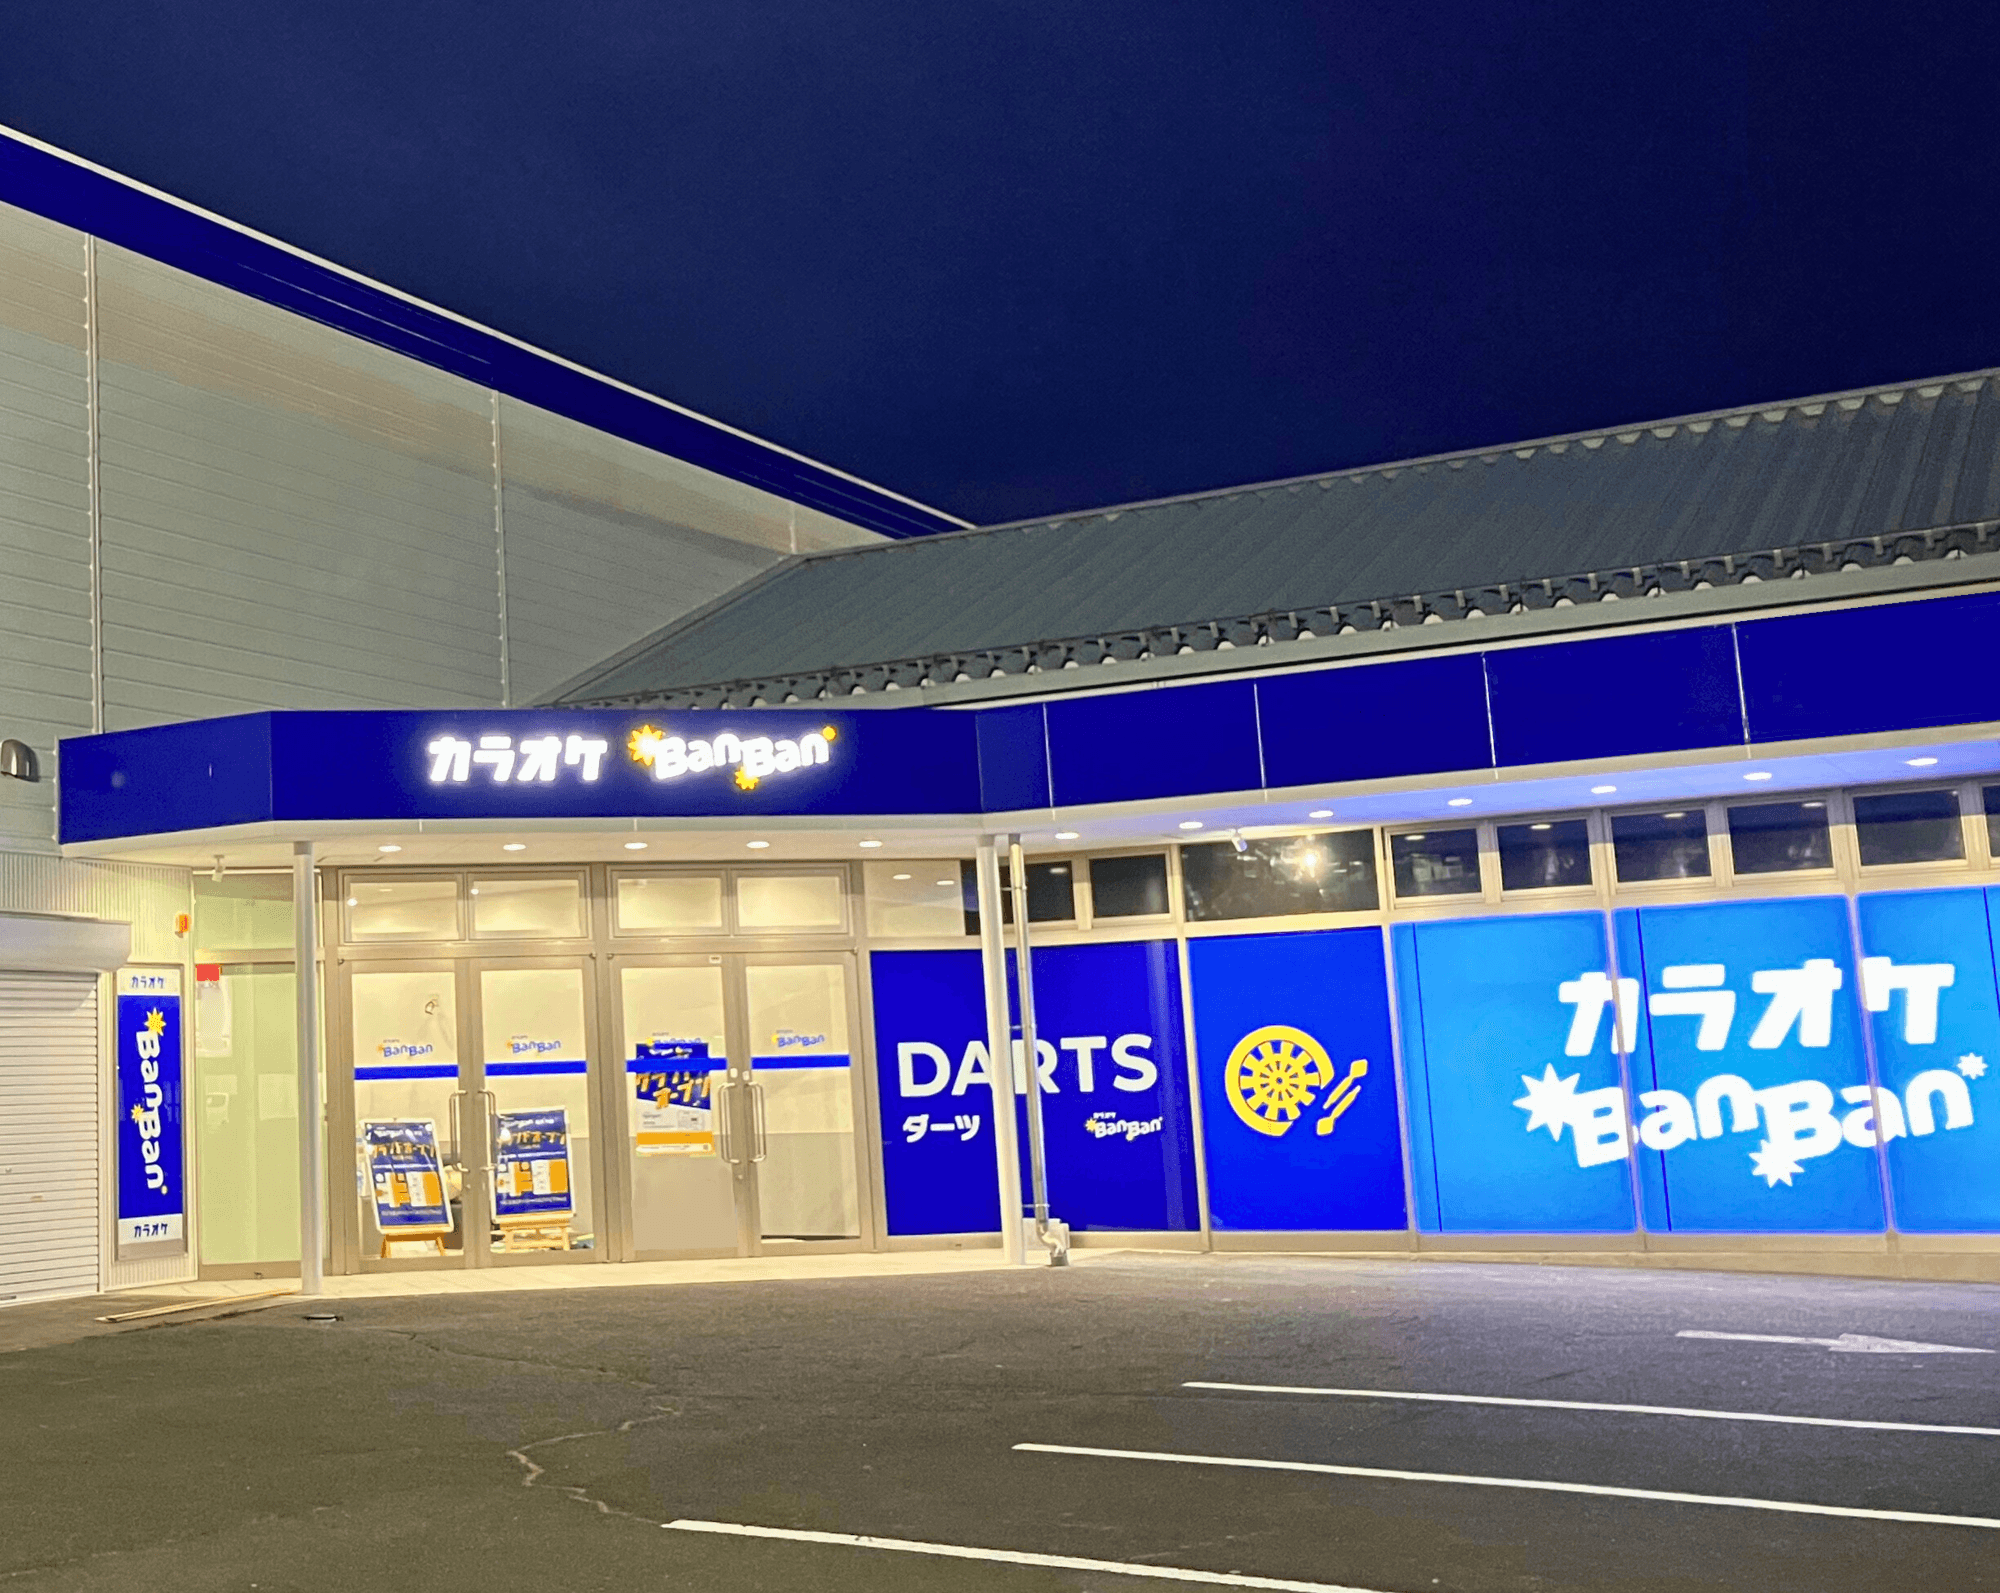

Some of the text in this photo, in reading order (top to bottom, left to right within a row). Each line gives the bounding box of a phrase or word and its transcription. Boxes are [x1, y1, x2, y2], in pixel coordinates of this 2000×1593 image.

[429, 733, 829, 781] カラオケ BanBan
[131, 976, 165, 988] カラオケ
[1558, 957, 1954, 1056] カラオケ
[383, 1044, 433, 1058] BanBan
[513, 1040, 561, 1054] BanBan
[778, 1034, 825, 1048] BanBan
[897, 1034, 1157, 1097] DARTS
[136, 1030, 164, 1189] BanBan
[1573, 1069, 1974, 1167] BanBan
[903, 1114, 980, 1142] ダーツ
[1095, 1119, 1161, 1138] BanBan
[134, 1223, 168, 1238] カラオケ
